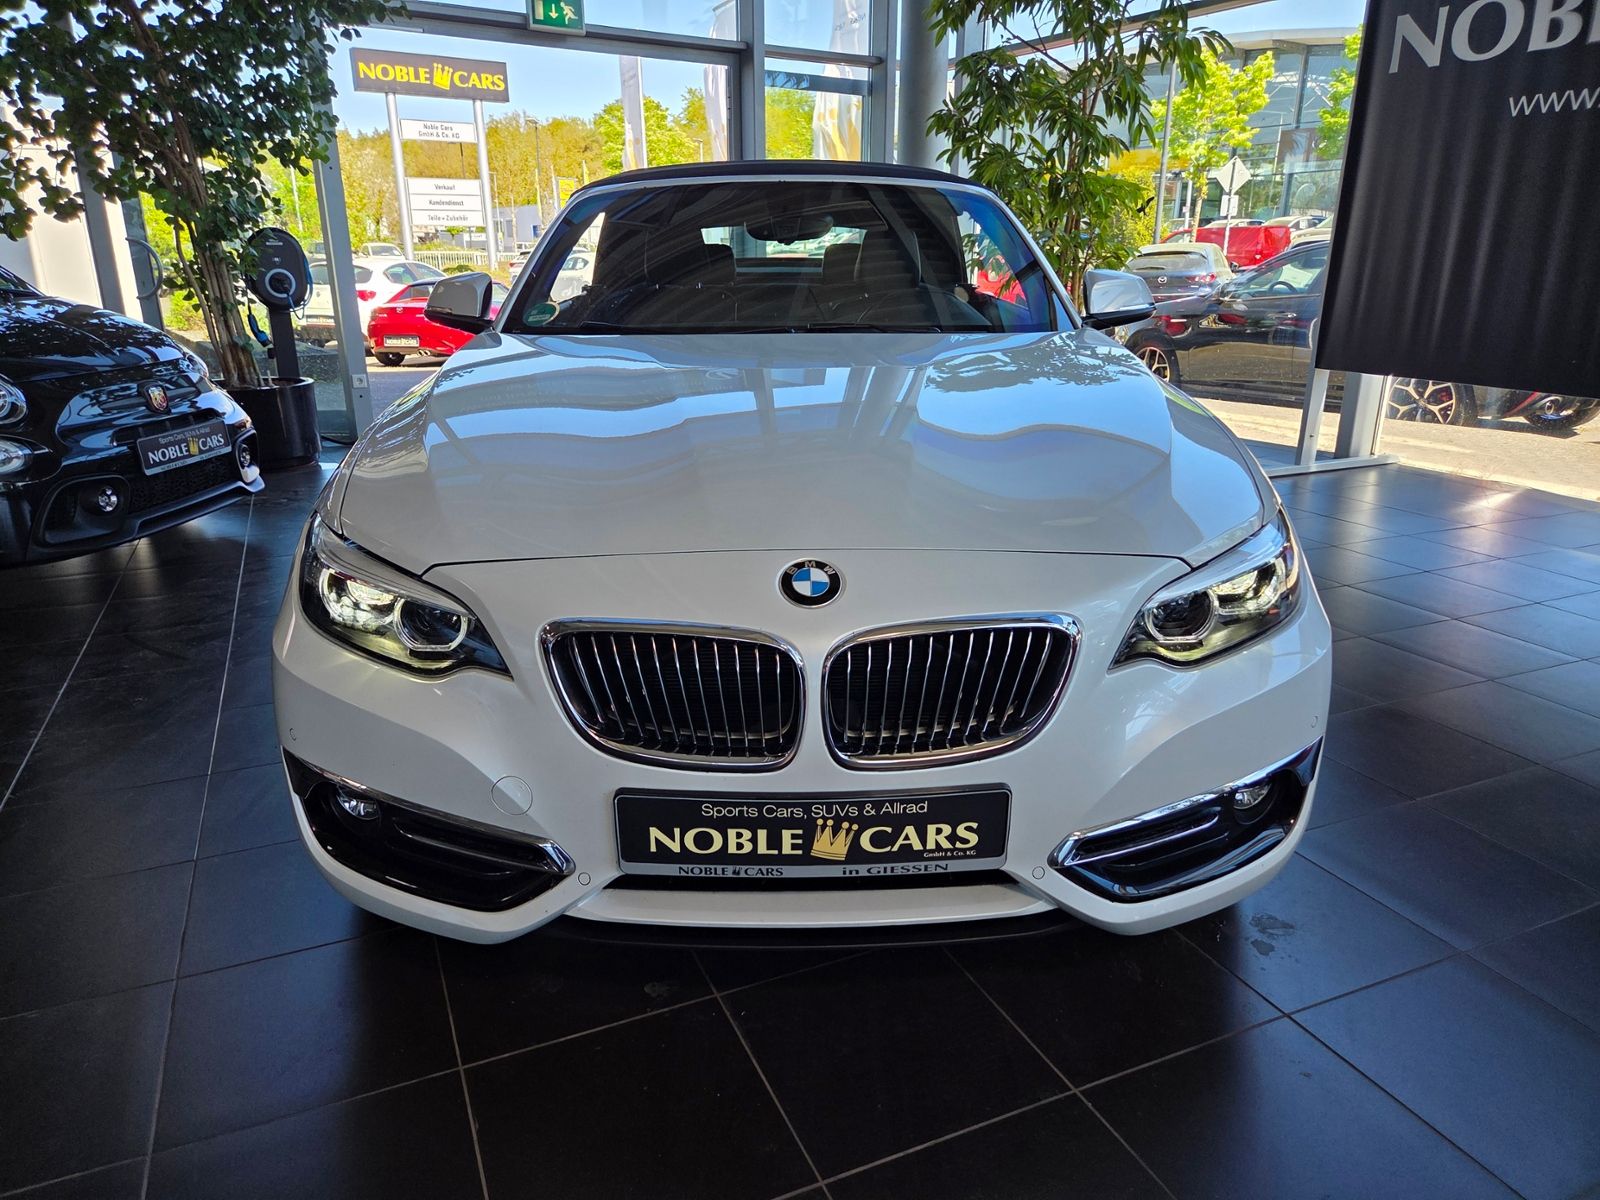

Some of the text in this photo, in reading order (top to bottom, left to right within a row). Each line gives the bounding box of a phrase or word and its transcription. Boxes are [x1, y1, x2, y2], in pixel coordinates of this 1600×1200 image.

[358, 61, 505, 91] NOBLE CARS
[148, 443, 189, 464] NOBLE
[199, 433, 225, 450] CARS
[785, 561, 836, 575] BMW
[701, 801, 928, 819] Sports Cars, SUVs & Allrad
[649, 821, 979, 854] NOBLE CARS
[678, 863, 949, 877] NOBLE CARS in GIESSEN
